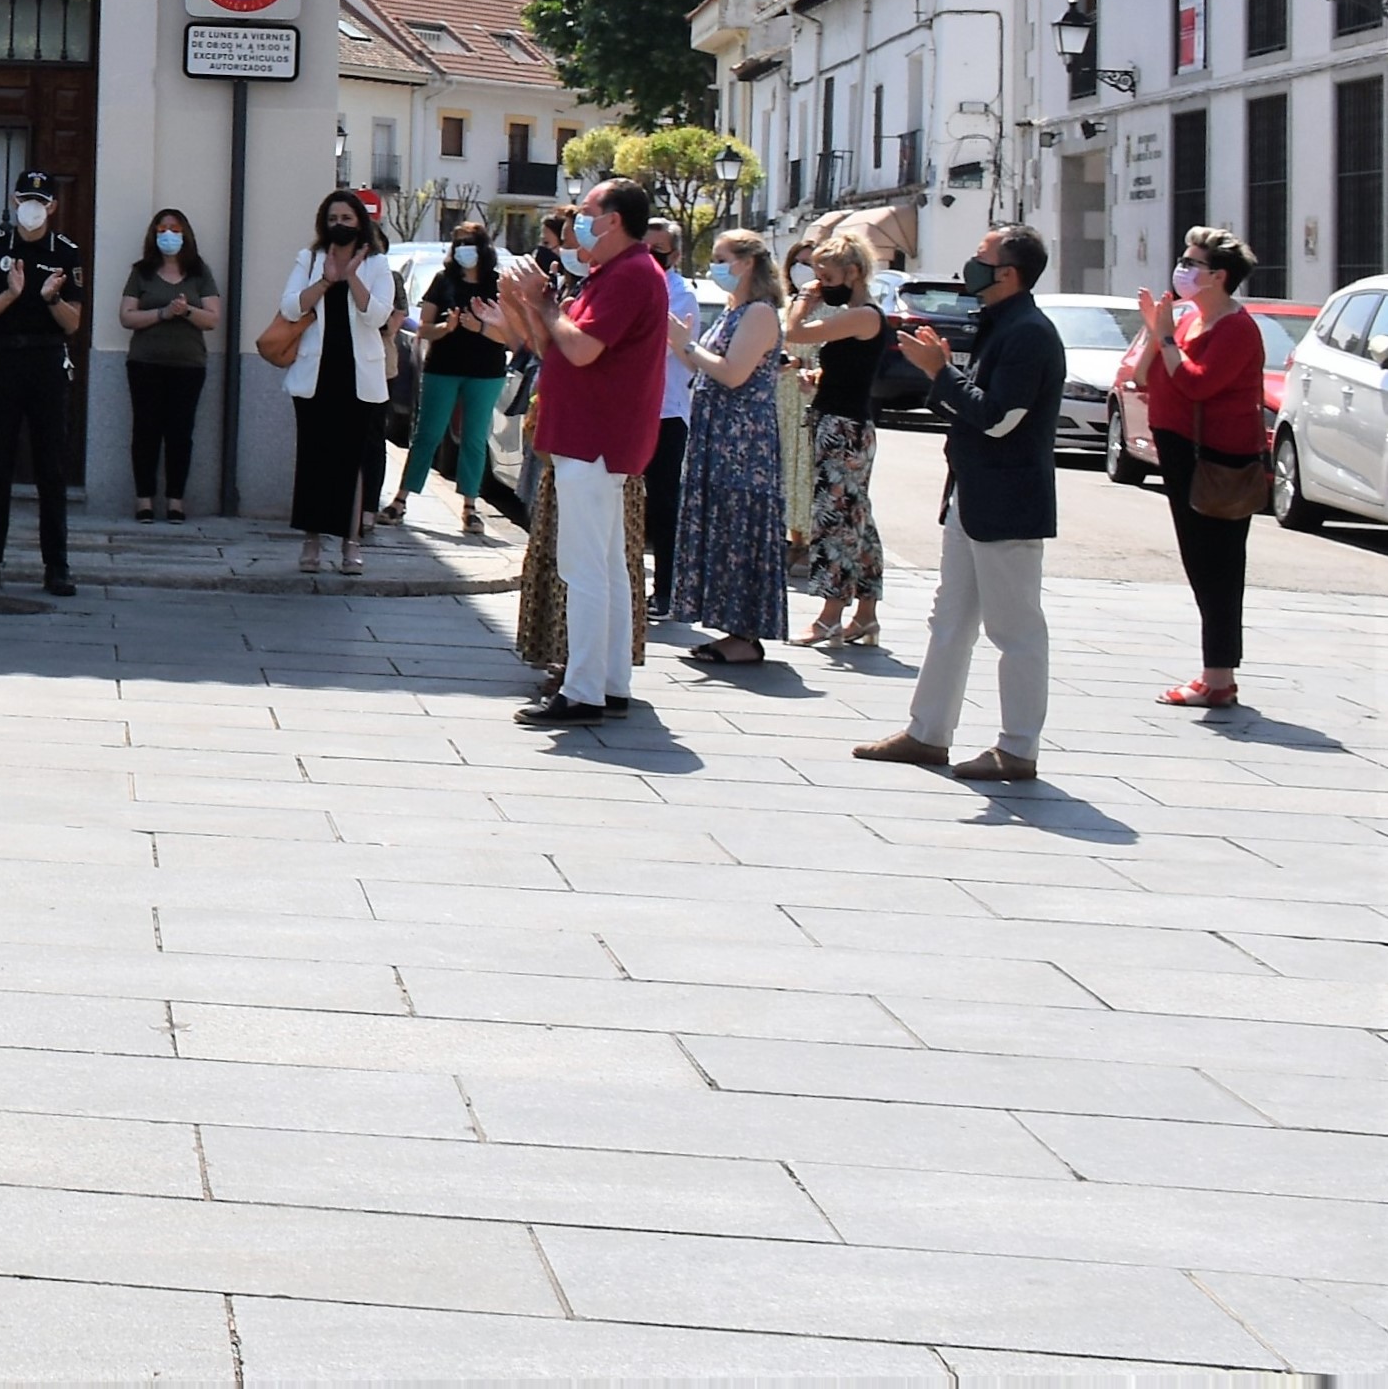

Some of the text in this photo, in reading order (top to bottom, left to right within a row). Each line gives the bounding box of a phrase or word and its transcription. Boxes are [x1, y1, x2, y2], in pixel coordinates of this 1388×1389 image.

[193, 30, 292, 42] DE LUNES A VIERNES
[191, 40, 203, 49] DE
[247, 42, 254, 51] A
[193, 52, 235, 61] EXCEPTO
[209, 63, 274, 73] AUTORIZADOS
